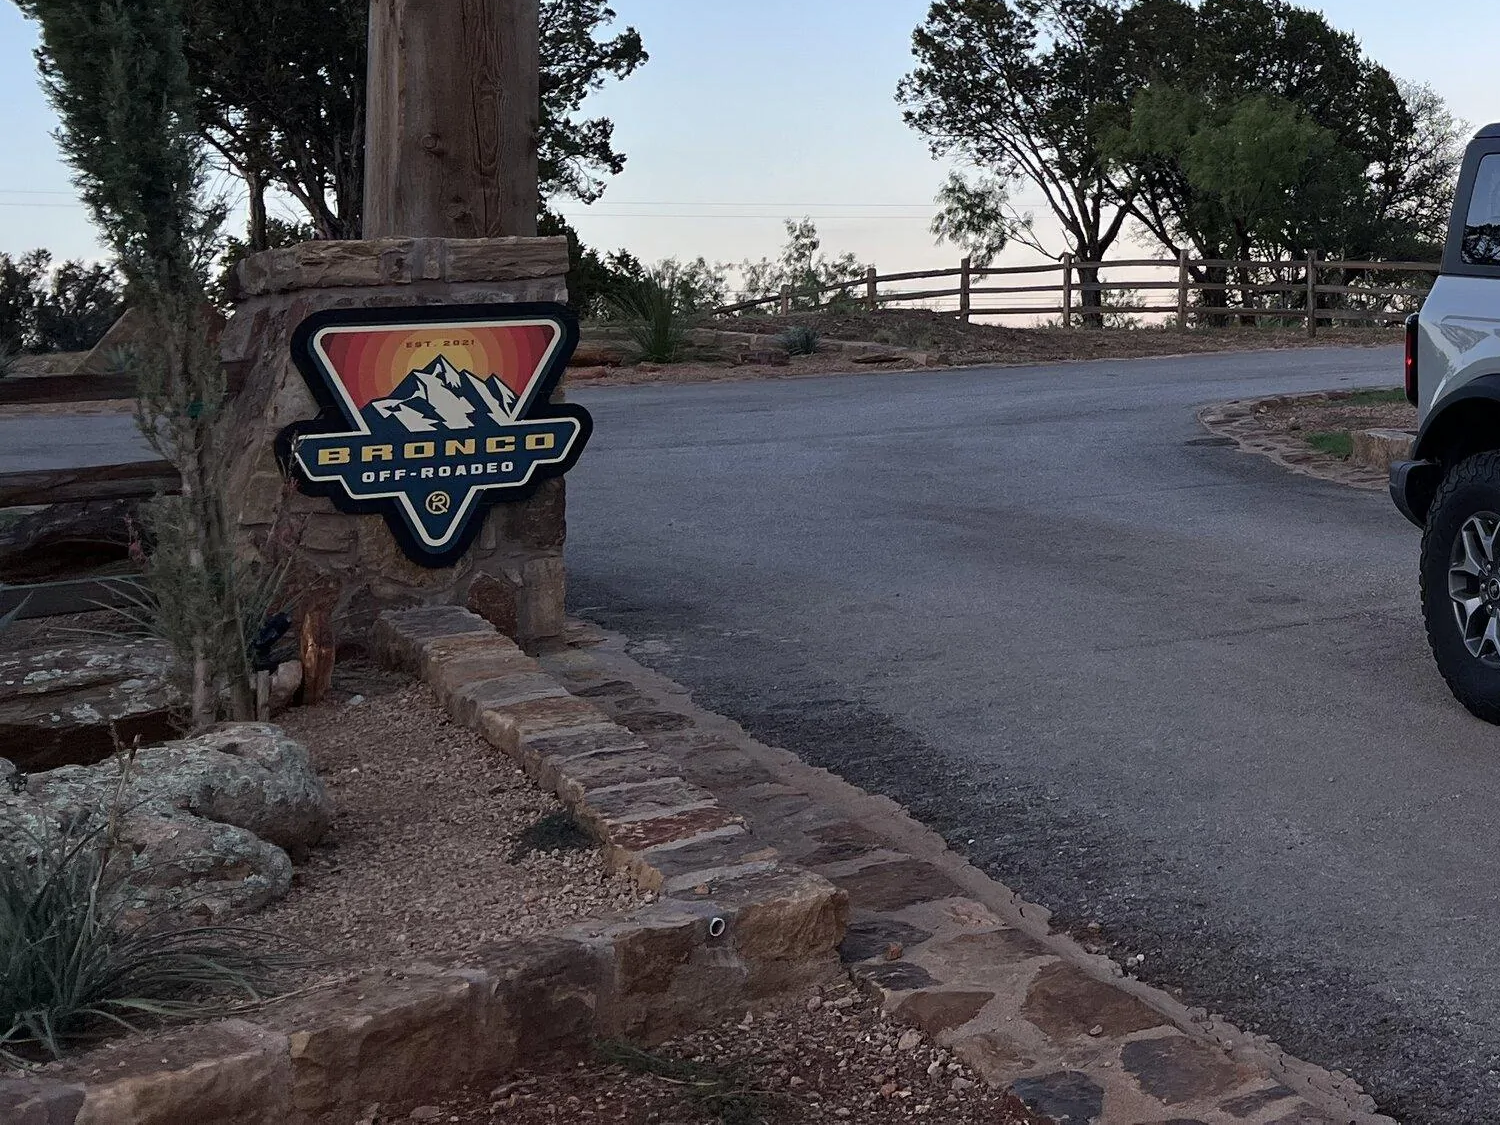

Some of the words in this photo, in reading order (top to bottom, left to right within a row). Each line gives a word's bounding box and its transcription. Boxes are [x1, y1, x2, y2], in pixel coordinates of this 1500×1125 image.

[405, 340, 437, 348] EST.
[443, 339, 475, 347] 2021
[318, 433, 555, 465] BRONCO
[361, 461, 514, 483] OFF-ROADEO
